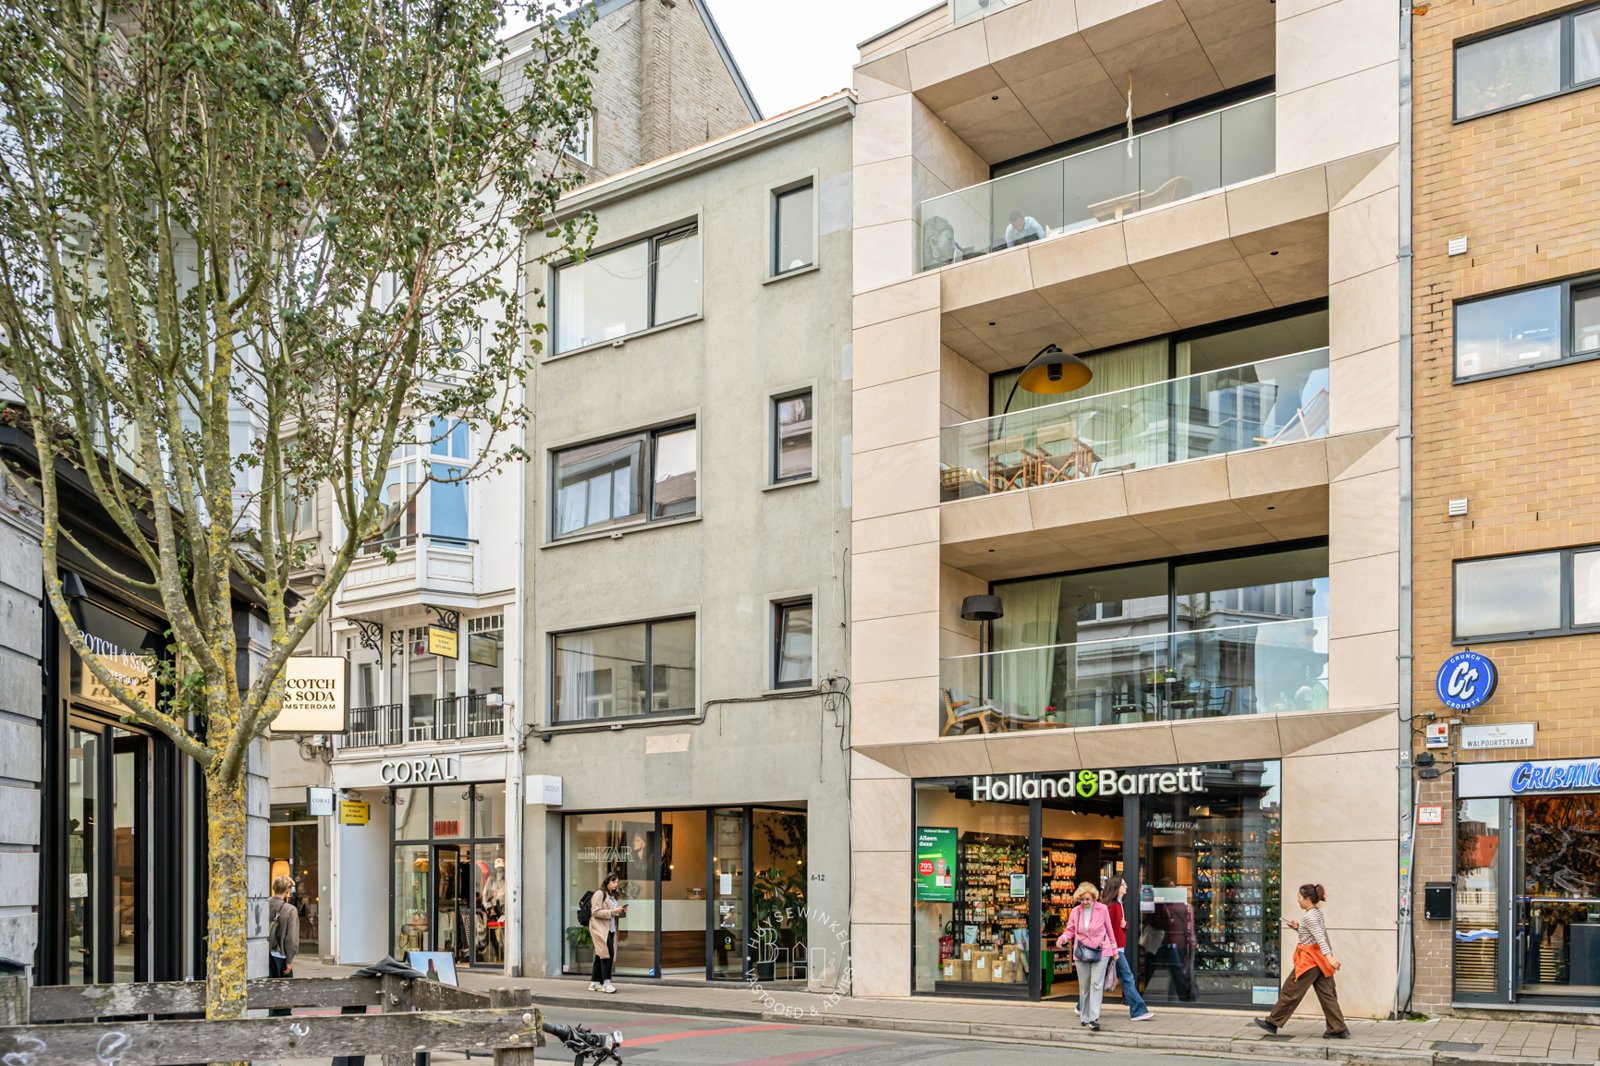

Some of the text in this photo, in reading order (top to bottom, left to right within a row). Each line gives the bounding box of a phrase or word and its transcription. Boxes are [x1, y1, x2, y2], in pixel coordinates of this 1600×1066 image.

[1449, 653, 1482, 664] CRUNCH
[285, 678, 336, 690] COTCH
[295, 691, 335, 702] SODA
[1446, 697, 1481, 709] CROUSTY
[1467, 738, 1529, 748] WALPOORTSTRAAT
[380, 758, 457, 784] CORAL
[584, 845, 634, 863] BIZAR
[1426, 911, 1431, 919] 2
